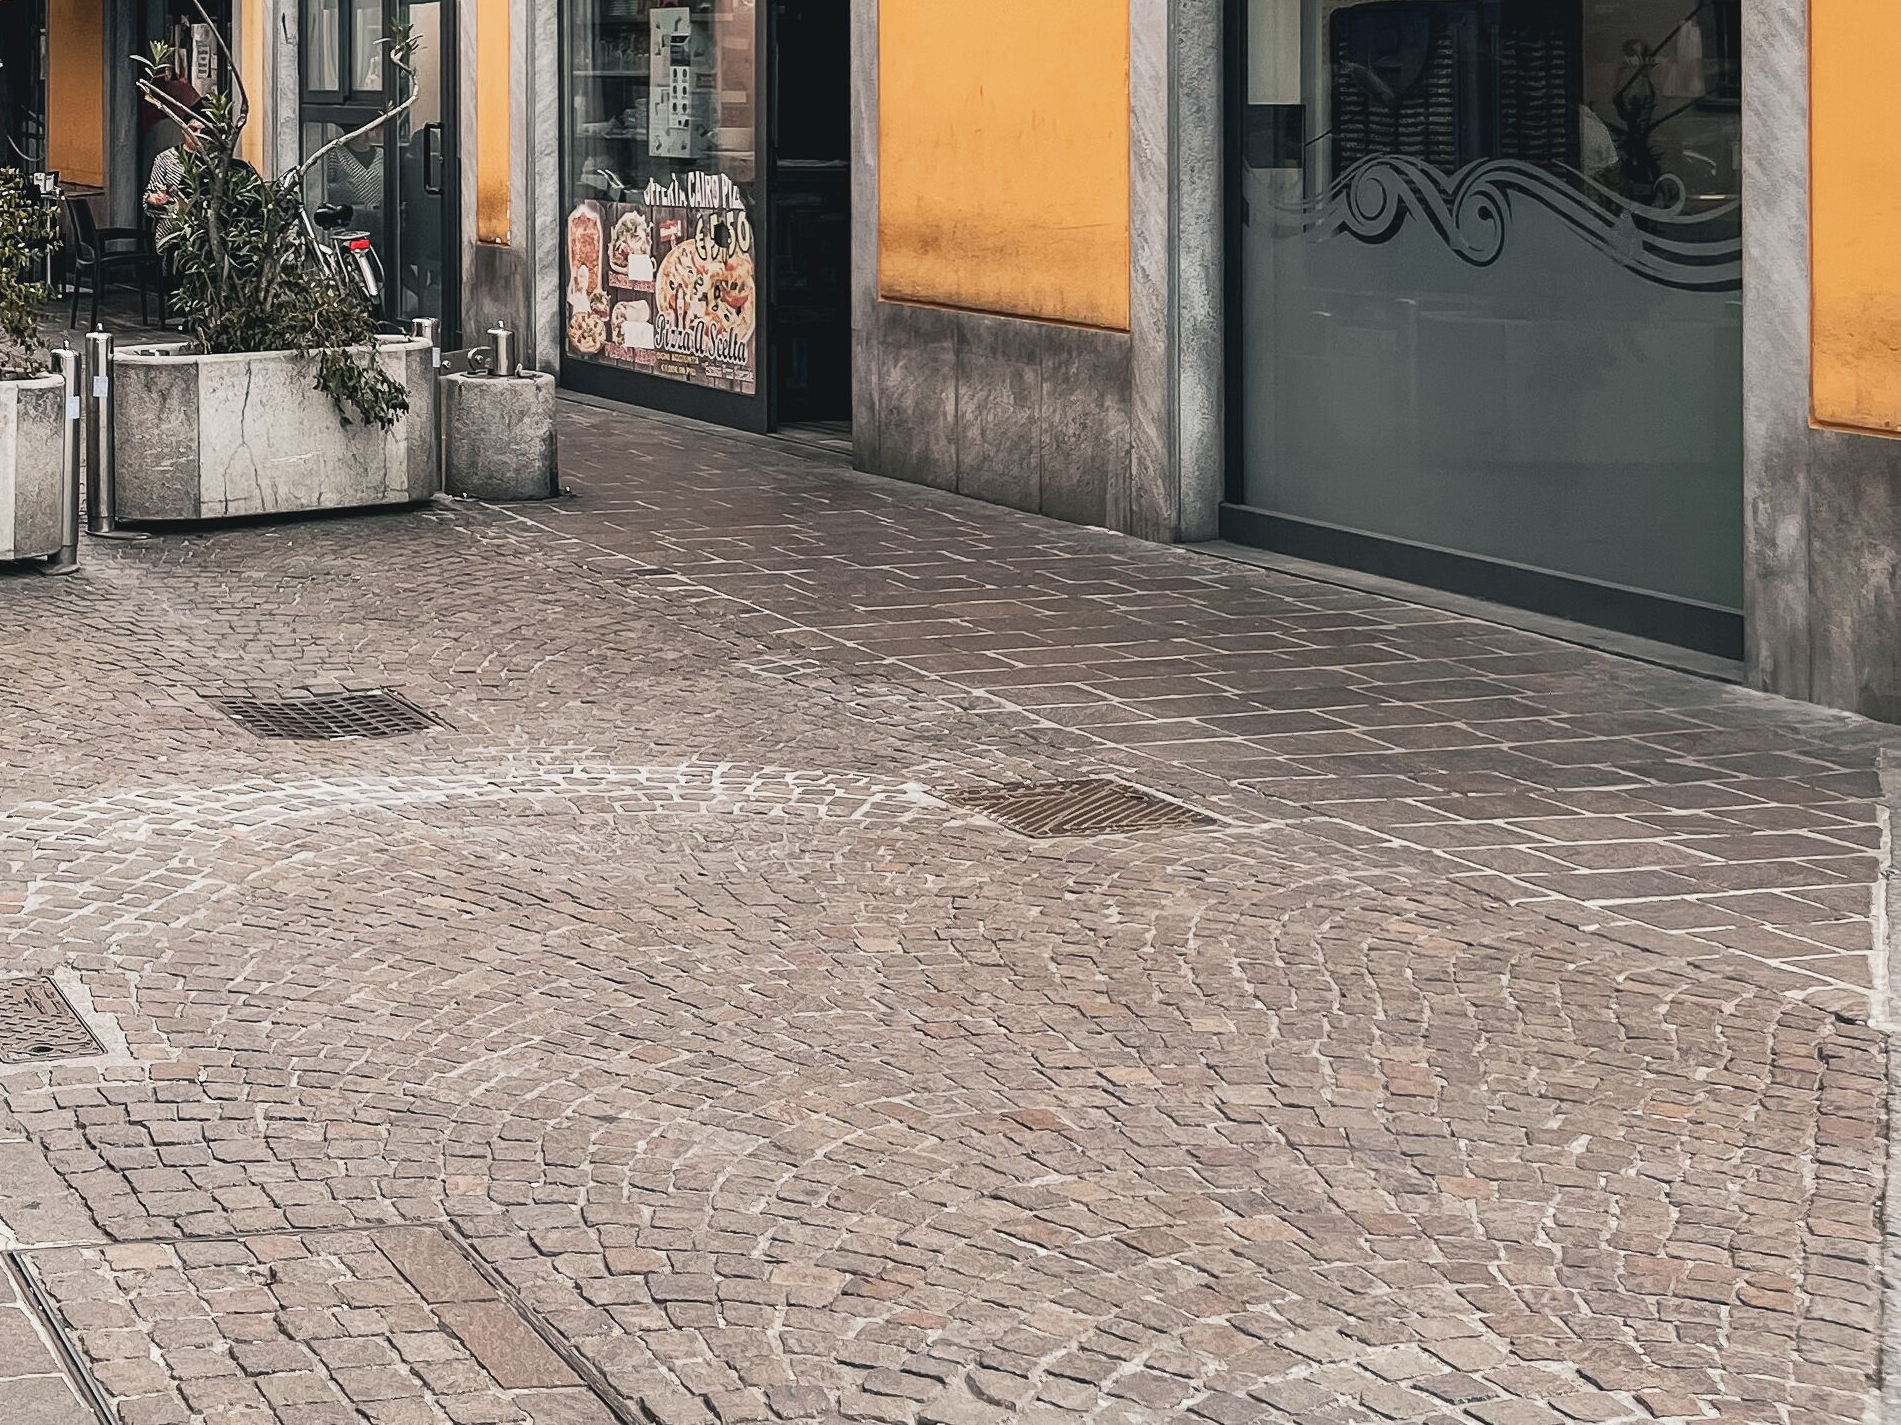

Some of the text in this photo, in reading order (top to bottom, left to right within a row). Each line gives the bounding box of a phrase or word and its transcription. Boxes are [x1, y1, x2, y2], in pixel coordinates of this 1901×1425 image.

[687, 171, 720, 209] CAIRO
[654, 313, 691, 353] Pizza
[694, 320, 705, 354] A
[708, 322, 747, 363] Scelta
